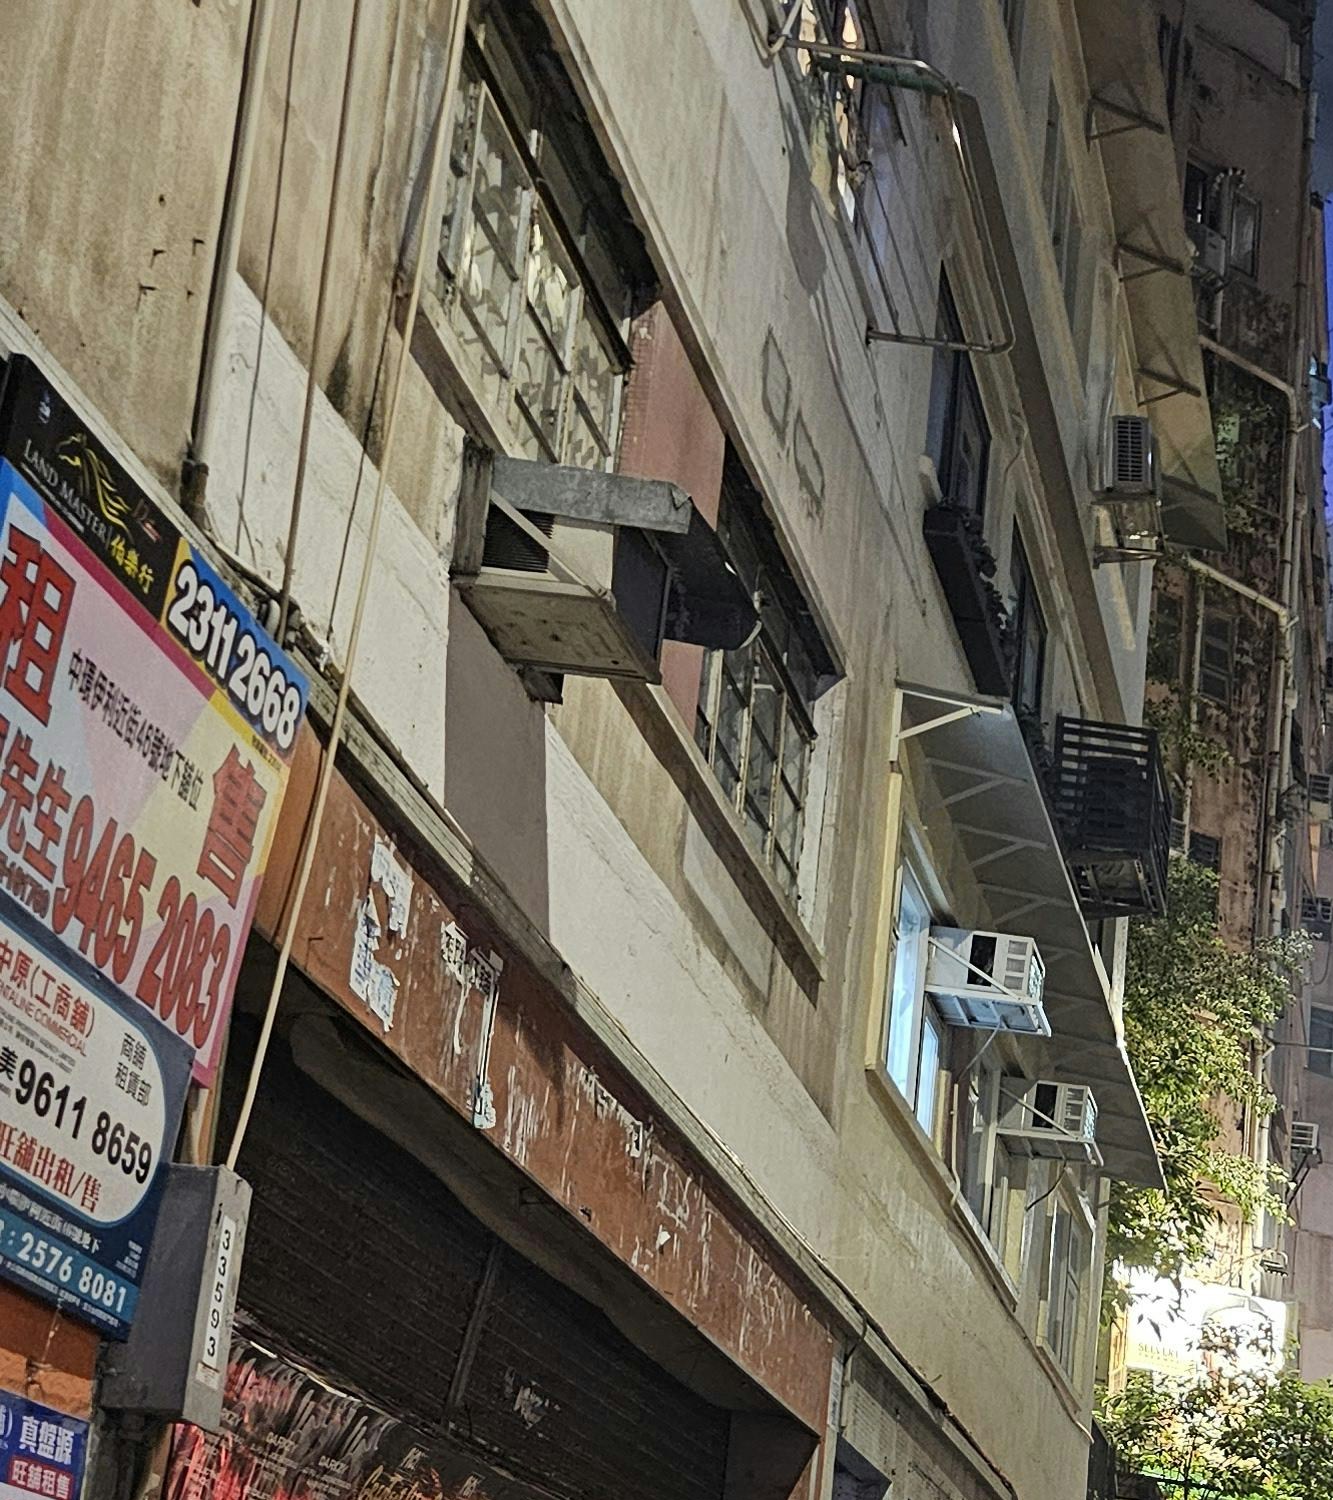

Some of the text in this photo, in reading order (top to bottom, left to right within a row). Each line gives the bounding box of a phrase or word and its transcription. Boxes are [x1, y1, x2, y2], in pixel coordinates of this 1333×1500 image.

[0, 522, 77, 727] 租
[166, 565, 239, 680] 2311
[228, 635, 300, 750] 2668
[52, 795, 156, 985] 9465
[138, 875, 232, 1050] 2083
[15, 1059, 87, 1139] 9611
[92, 1111, 152, 1184] 8659
[17, 1232, 73, 1282] 2576
[78, 1265, 127, 1313] 8081
